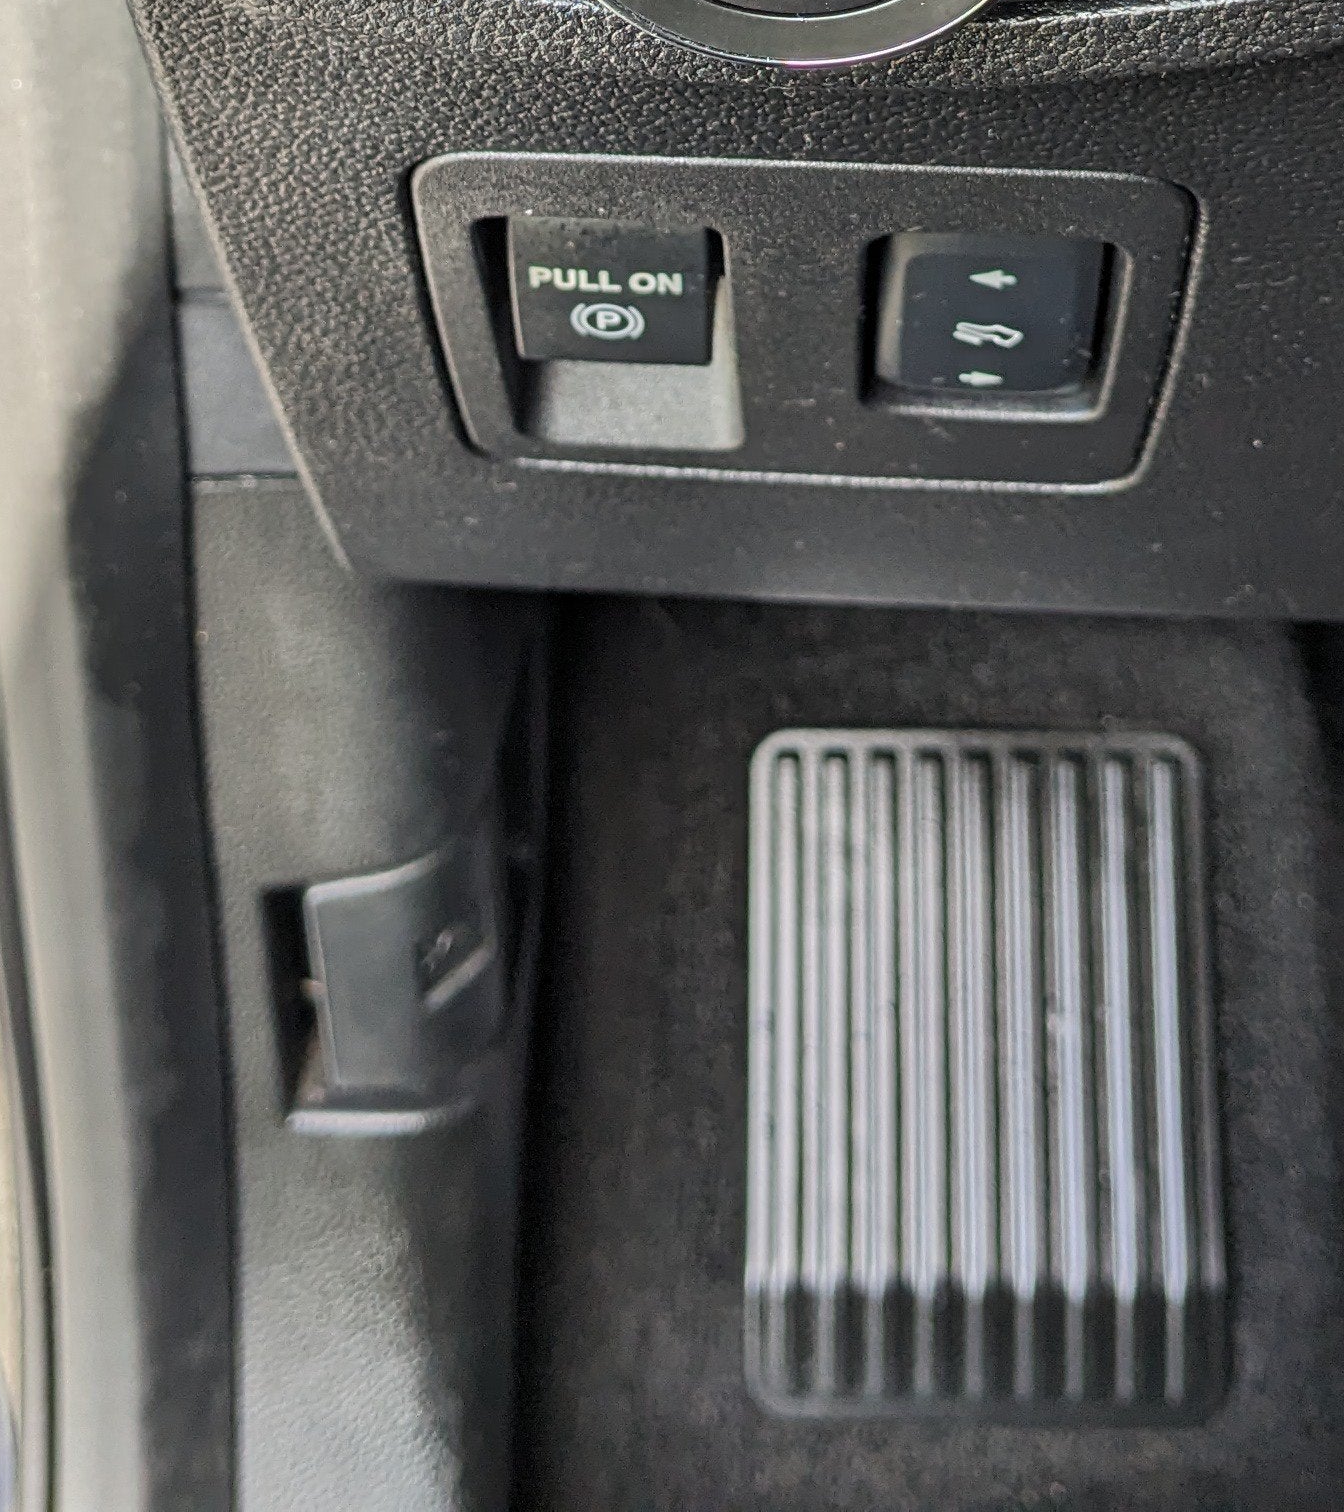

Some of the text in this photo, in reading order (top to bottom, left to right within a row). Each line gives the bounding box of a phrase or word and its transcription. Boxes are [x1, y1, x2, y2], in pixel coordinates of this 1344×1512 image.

[528, 265, 683, 296] PULL ON
[596, 310, 621, 330] P
